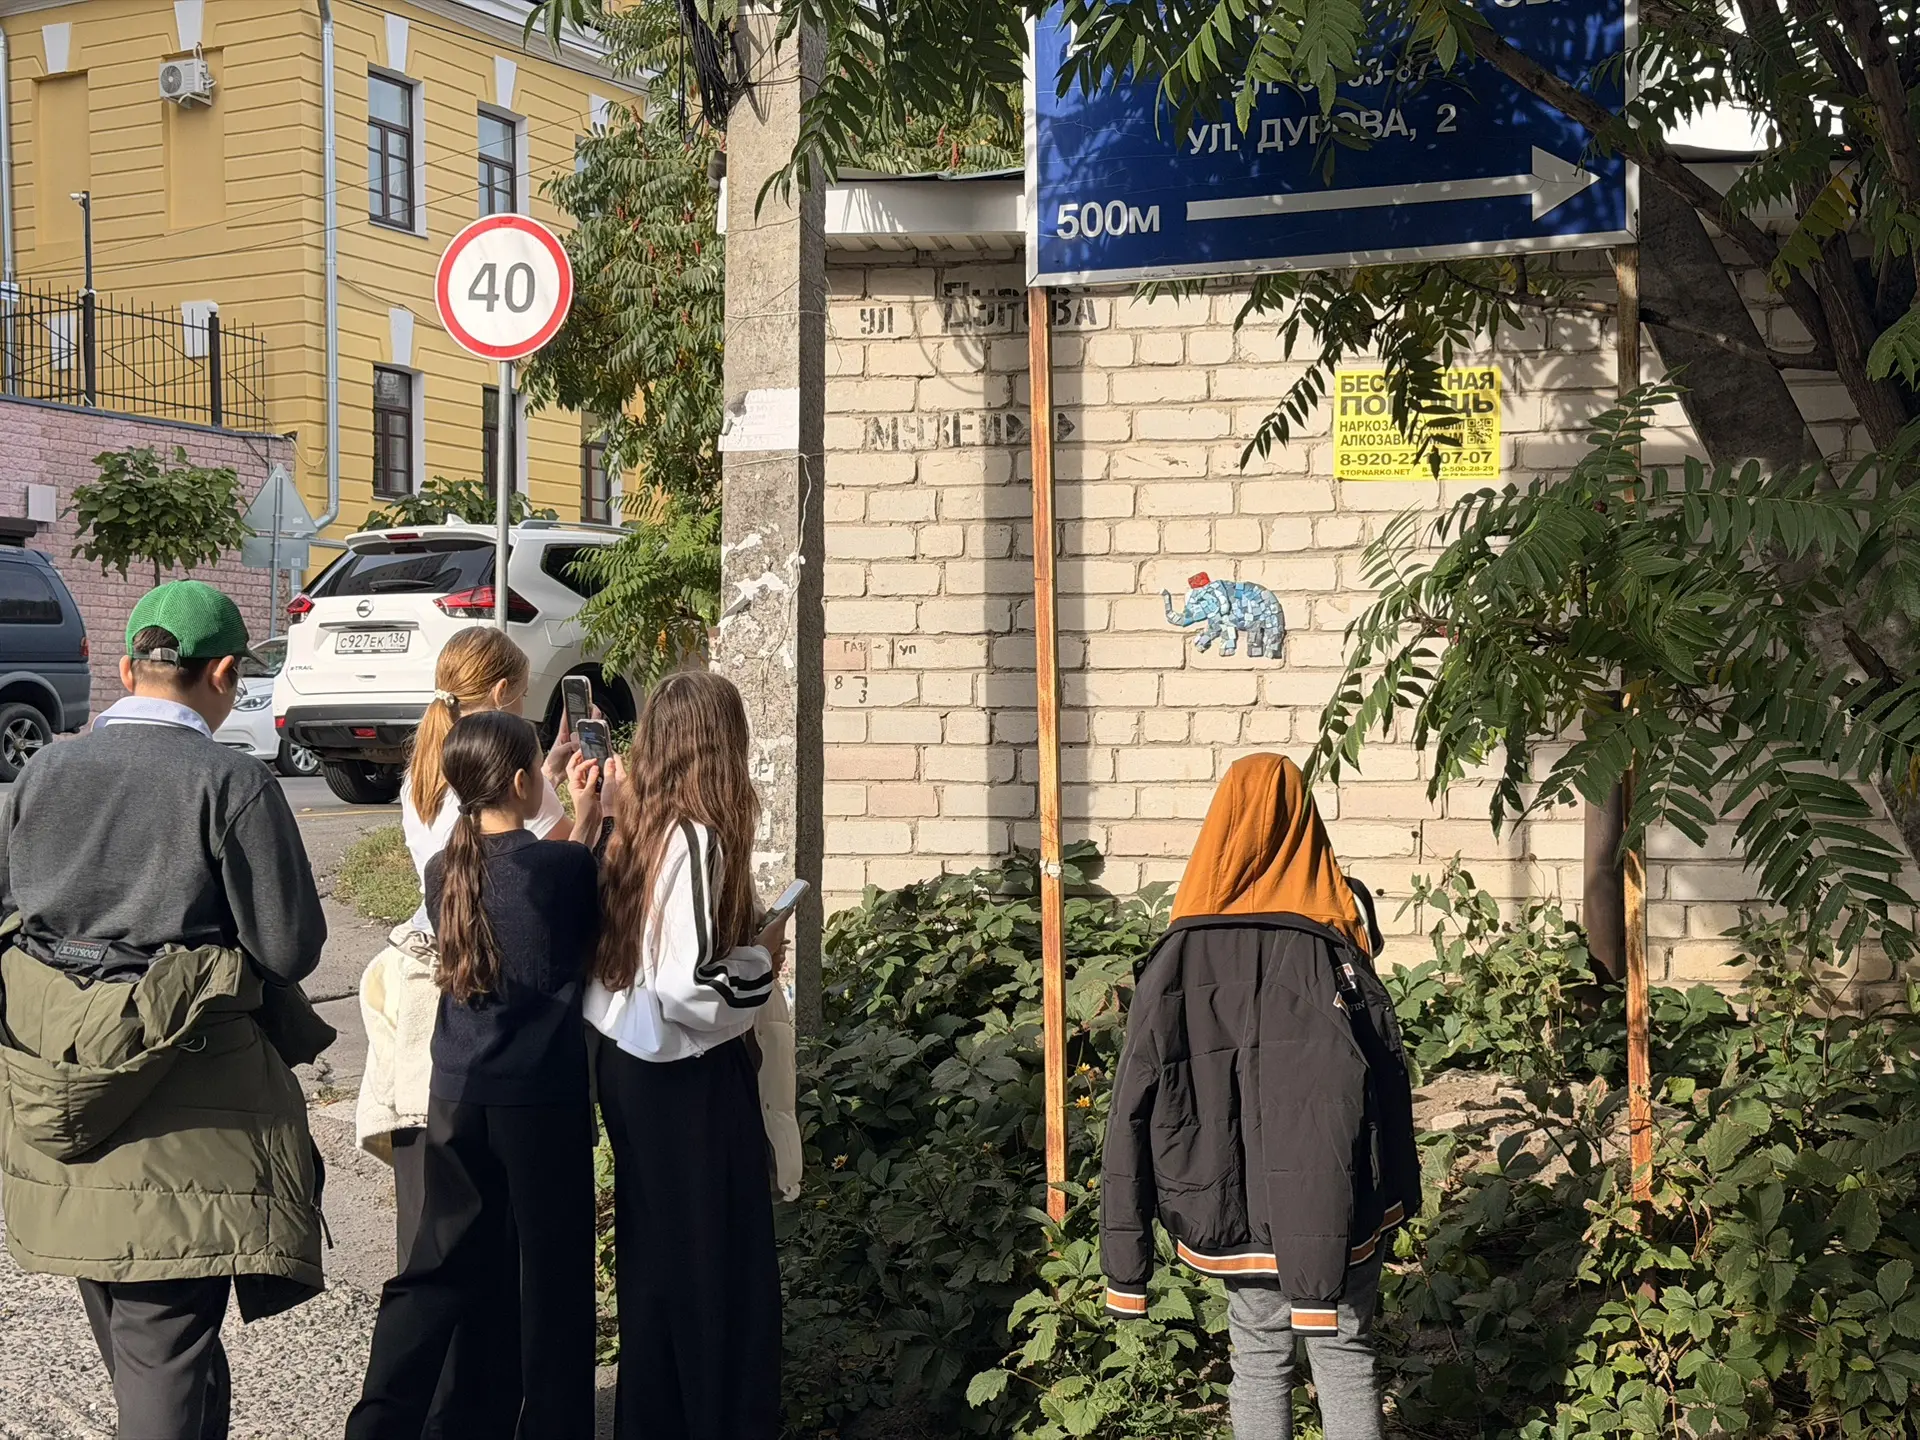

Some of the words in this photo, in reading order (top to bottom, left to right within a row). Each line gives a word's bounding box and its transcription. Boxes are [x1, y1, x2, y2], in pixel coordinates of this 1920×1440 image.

[1187, 121, 1238, 155] УЛ.
[1436, 103, 1457, 133] 2
[467, 261, 536, 314] 40
[1340, 468, 1411, 477] STOPNARKO.NET
[388, 632, 406, 643] 136
